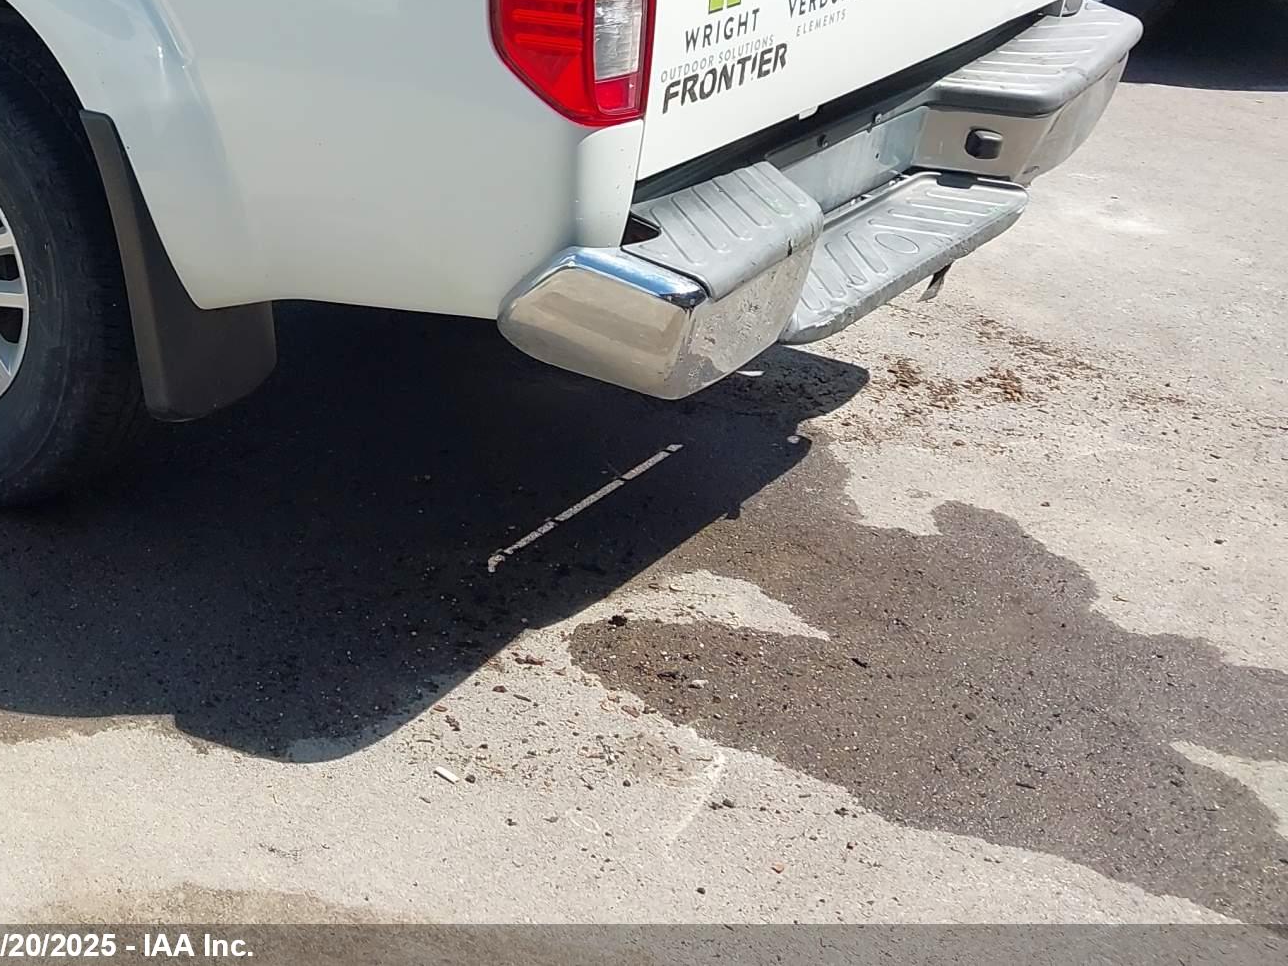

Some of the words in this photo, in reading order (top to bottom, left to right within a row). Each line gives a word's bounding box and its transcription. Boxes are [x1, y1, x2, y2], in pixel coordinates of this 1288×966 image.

[684, 7, 760, 54] WRIGHT
[795, 9, 847, 37] ELEMENTS
[660, 54, 714, 84] OUTDOOR
[718, 34, 774, 65] SOLUTIONS
[662, 42, 788, 114] FRONTIER
